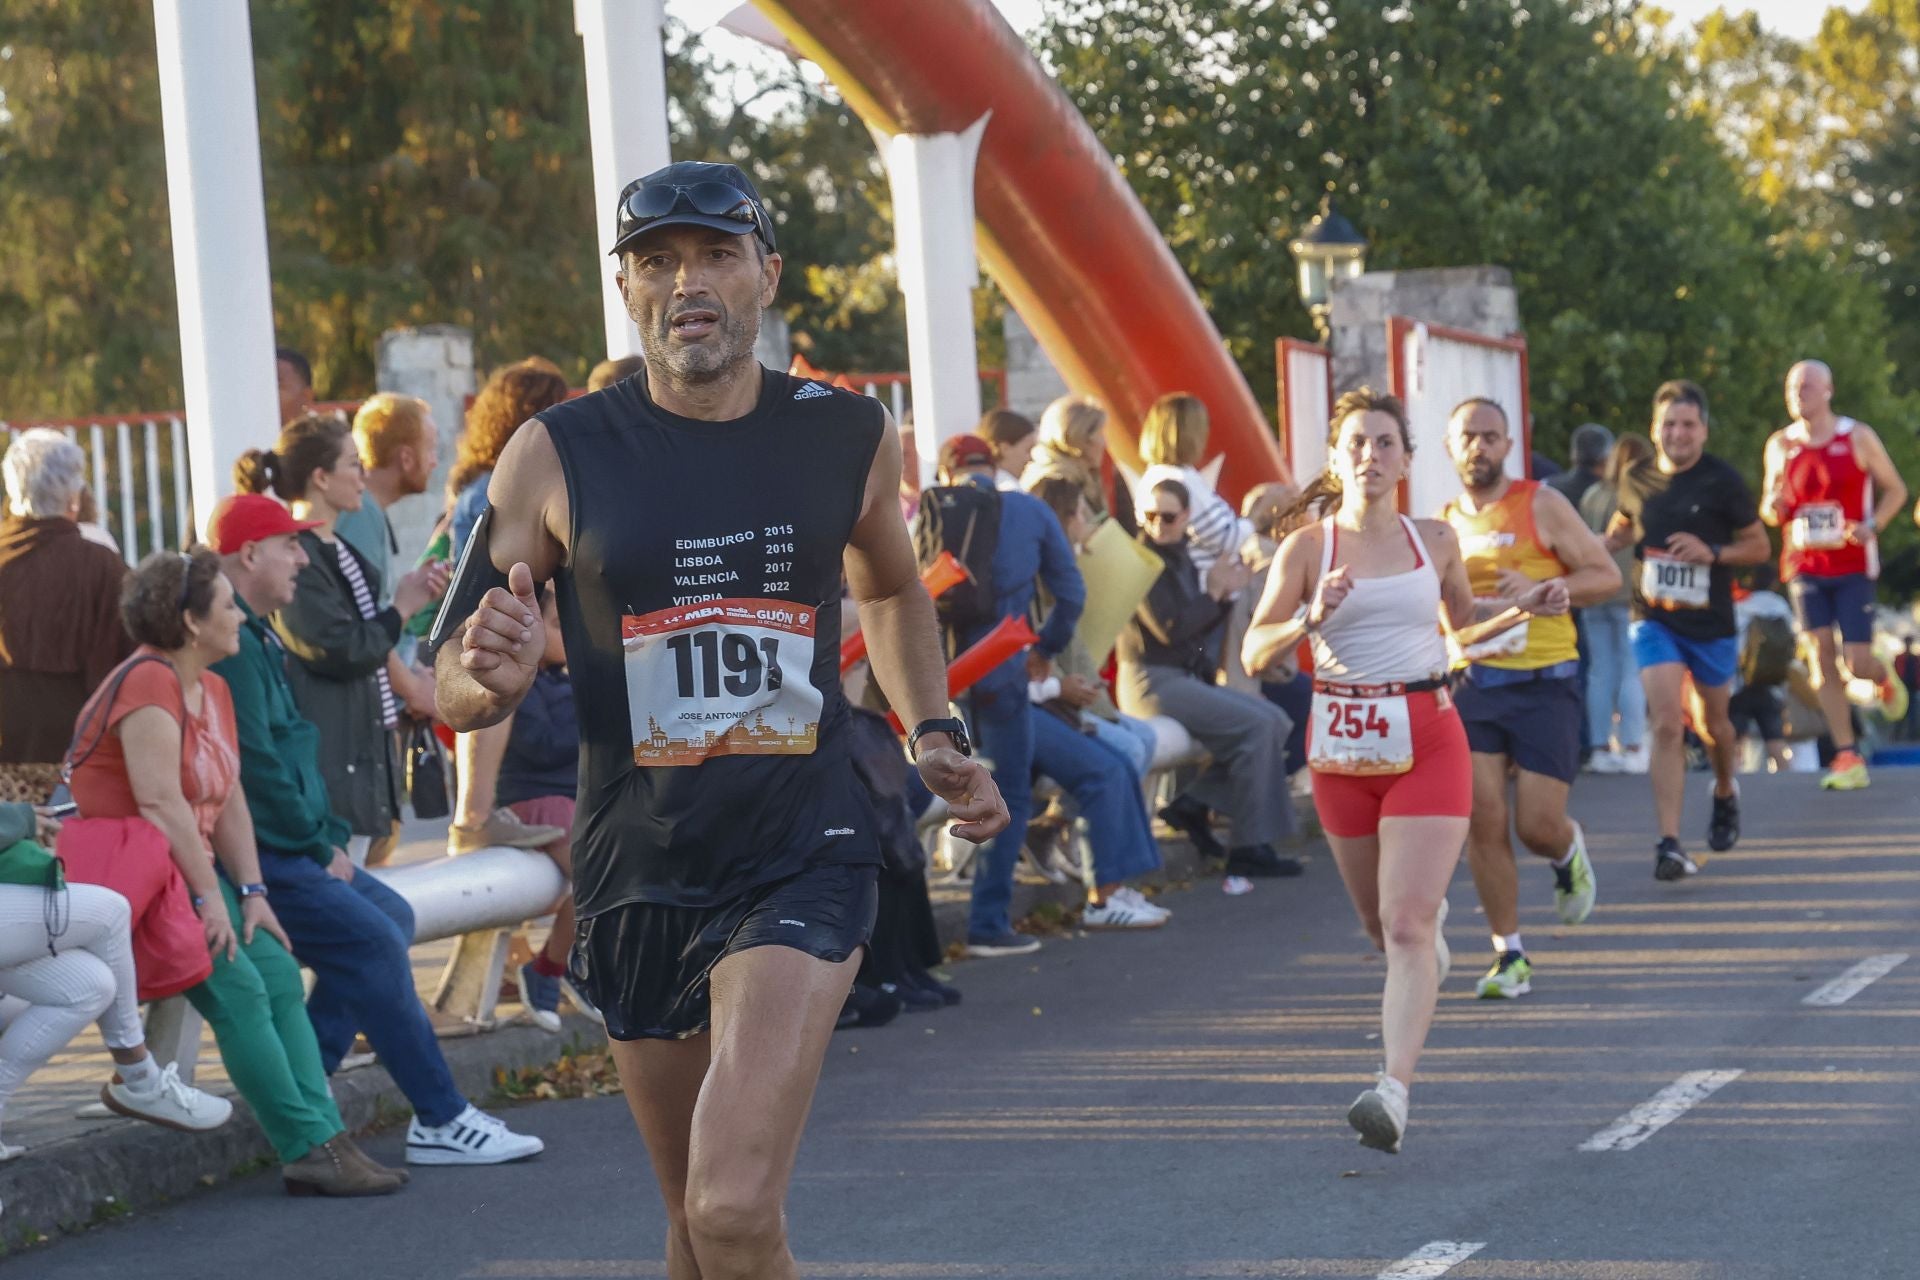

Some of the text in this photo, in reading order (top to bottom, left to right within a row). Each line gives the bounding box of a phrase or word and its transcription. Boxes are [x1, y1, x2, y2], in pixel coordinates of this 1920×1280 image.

[793, 390, 833, 400] adidas
[675, 524, 794, 550] EDIMBURGO 2015
[675, 543, 794, 568] LISBOA 2016
[674, 561, 793, 586] VALENCIA 2017
[1657, 563, 1695, 588] 1011
[672, 581, 790, 606] VITORIA 2022
[684, 607, 725, 621] MBA
[756, 609, 794, 624] GIJÓN
[666, 630, 783, 699] 1191
[678, 711, 749, 720] JOSE ANTONIO
[1327, 701, 1390, 739] 254
